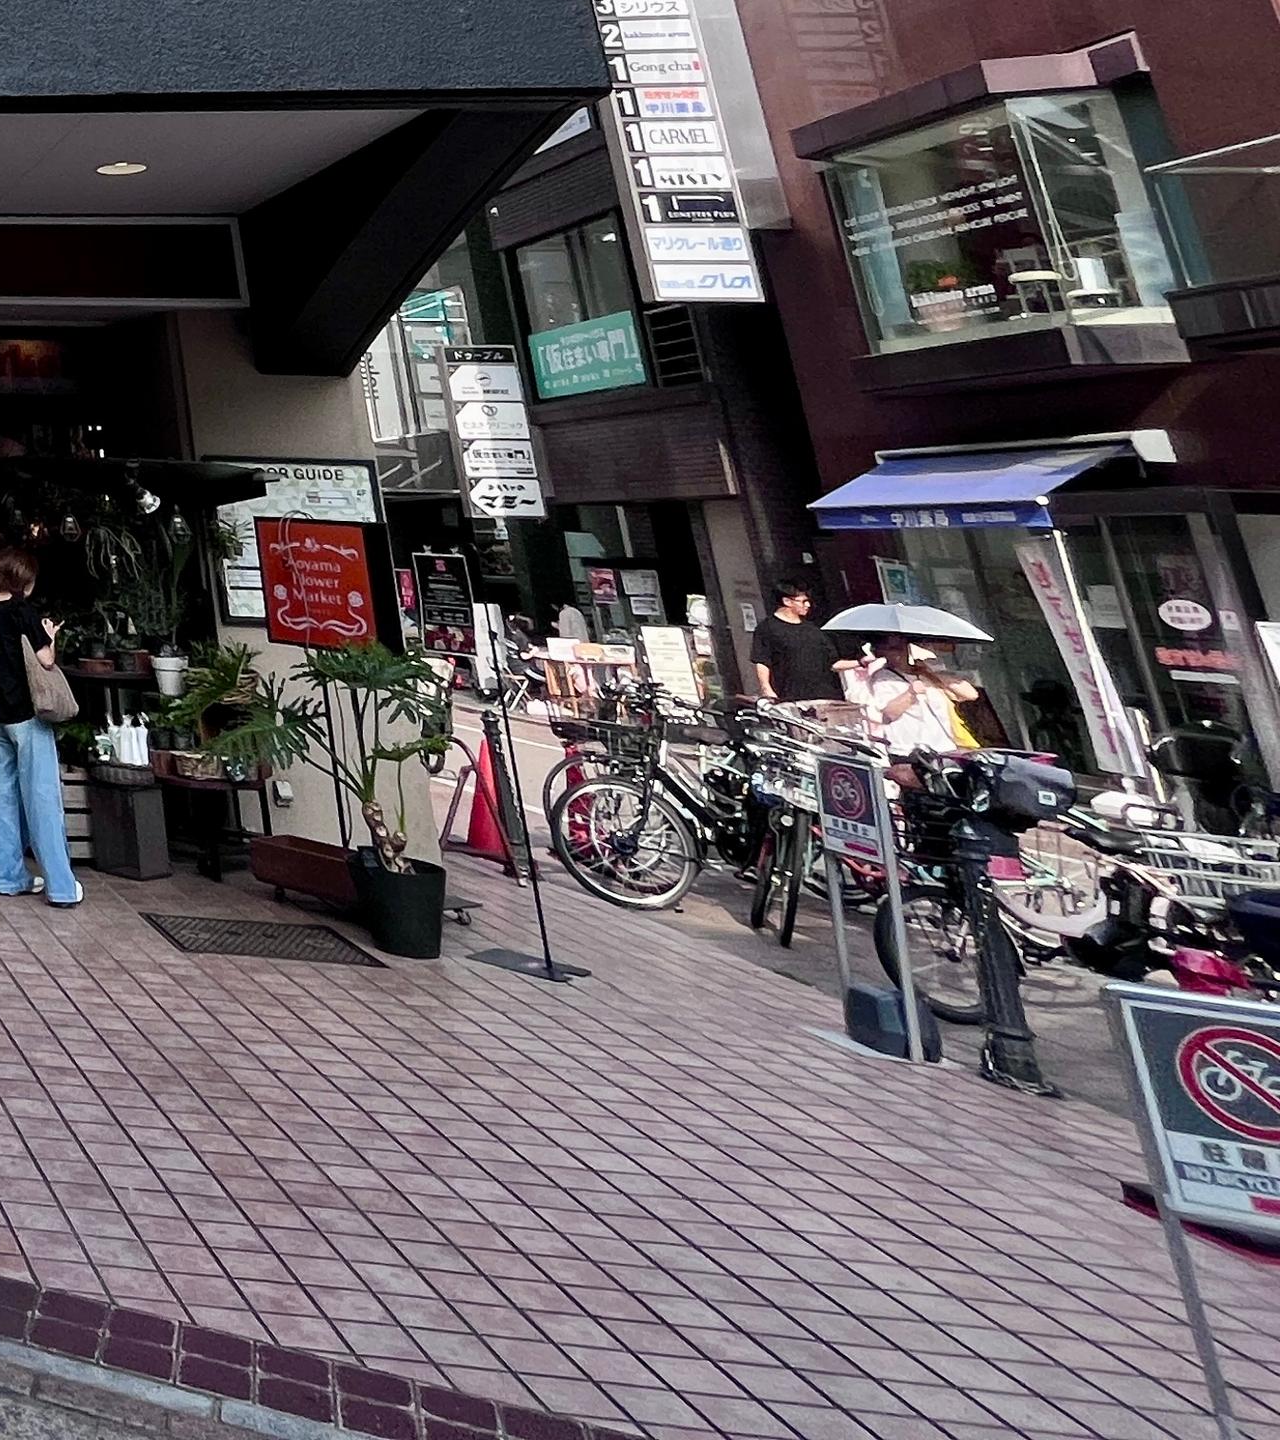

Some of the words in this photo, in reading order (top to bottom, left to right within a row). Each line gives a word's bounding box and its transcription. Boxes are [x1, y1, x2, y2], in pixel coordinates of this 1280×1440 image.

[620, 0, 680, 13] シリウス
[601, 23, 623, 47] 2
[608, 56, 628, 82] 1
[629, 61, 667, 75] Gong
[668, 60, 693, 72] cha
[616, 90, 636, 115] 1
[625, 123, 644, 152] 1
[648, 128, 715, 145] CARMEL
[634, 159, 653, 186] 1
[641, 194, 662, 222] 1
[649, 236, 743, 251] マリクレール通り
[293, 467, 345, 482] GUIDE
[478, 494, 537, 509] マミー
[286, 557, 342, 573] Aoyama
[292, 587, 342, 605] Market
